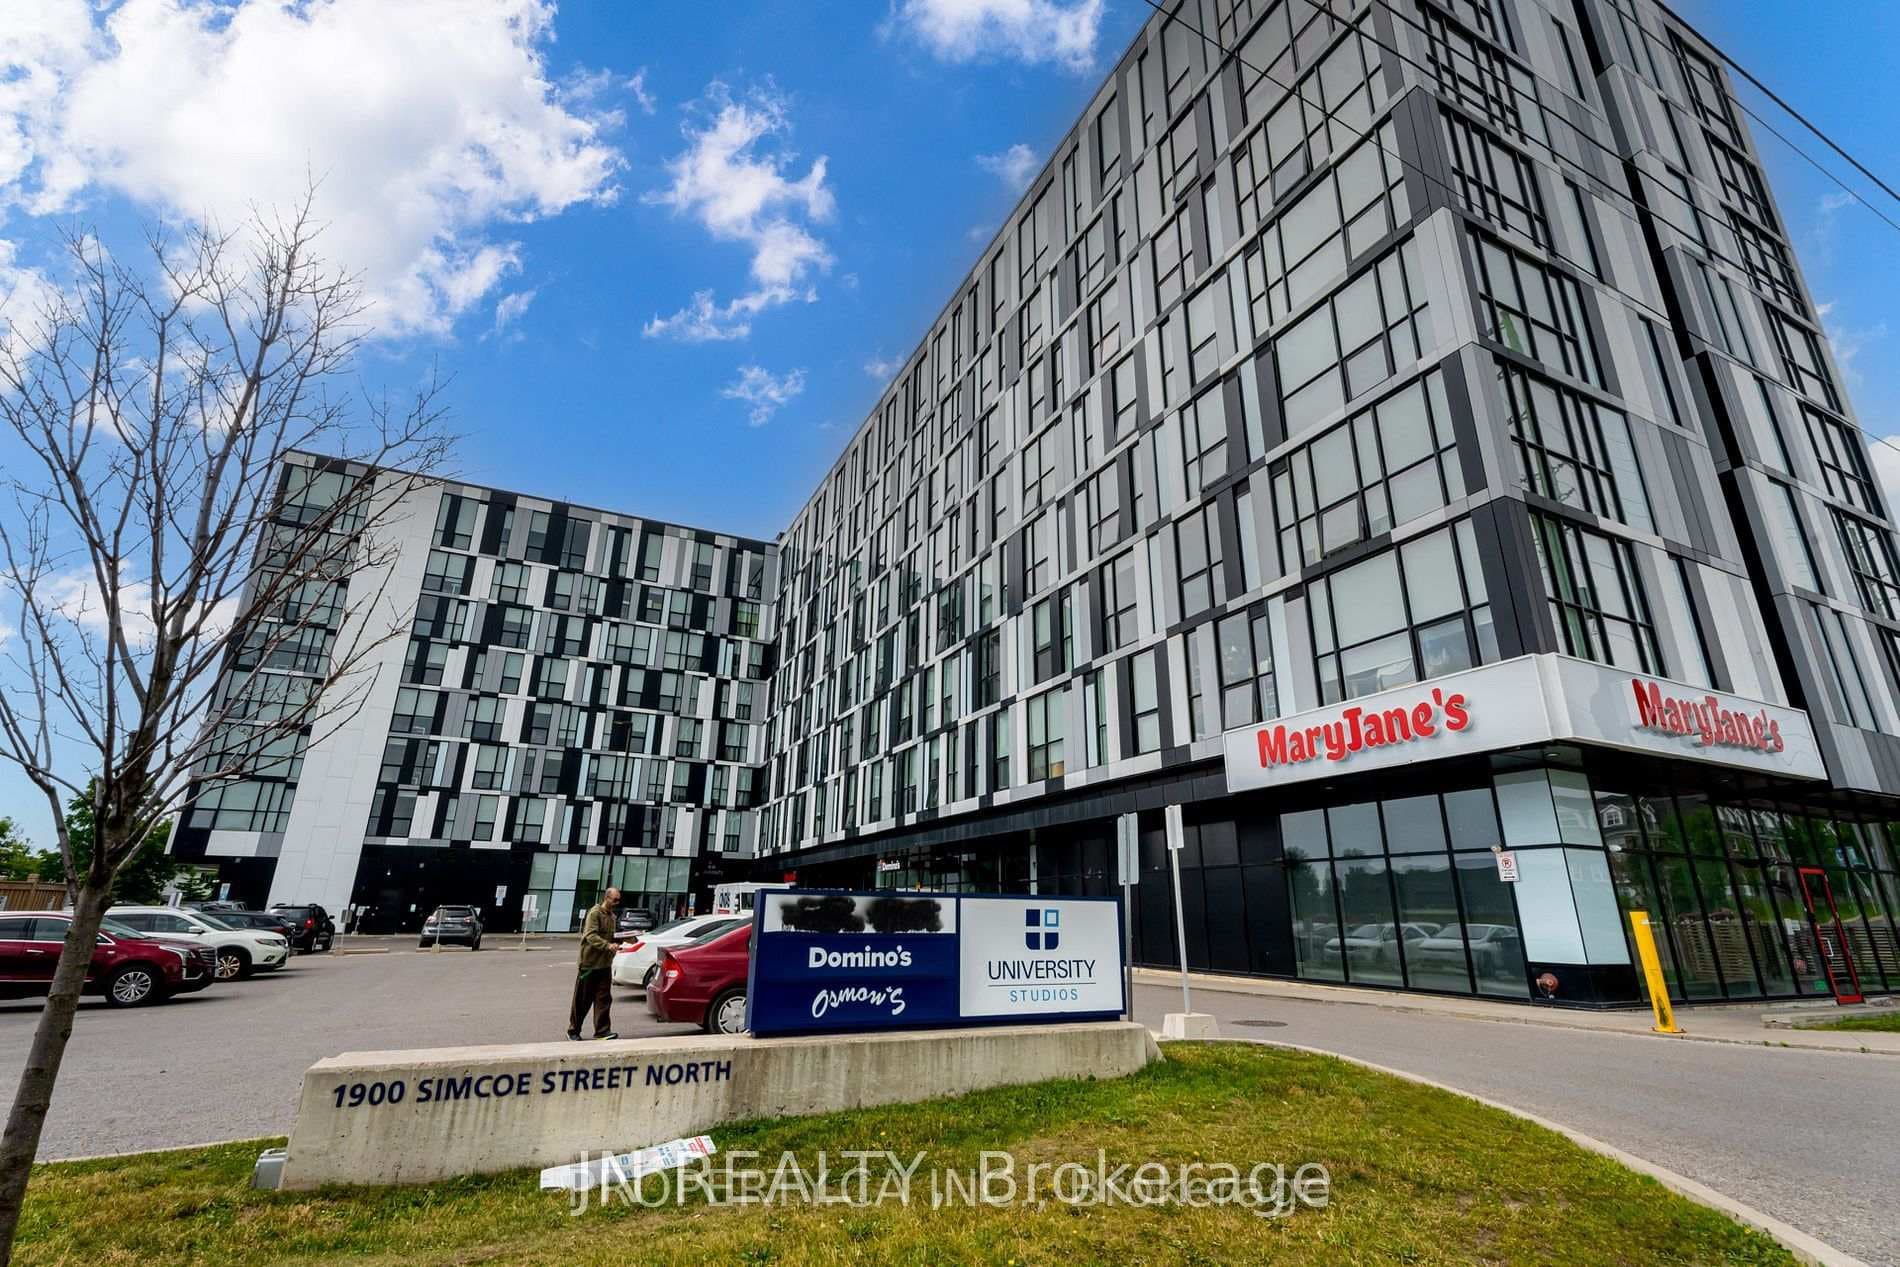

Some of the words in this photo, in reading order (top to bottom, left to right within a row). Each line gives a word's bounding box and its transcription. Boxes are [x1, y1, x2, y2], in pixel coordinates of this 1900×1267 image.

[1256, 687, 1470, 769] MaryJane's
[1632, 678, 1785, 753] MaryJane's
[808, 945, 912, 968] Domino's
[988, 959, 1096, 980] UNIVERSITY
[1009, 989, 1079, 1003] STUDIOS
[331, 1080, 406, 1108] 1900
[415, 1073, 532, 1104] SIMCOE
[541, 1066, 638, 1095] STREET
[645, 1061, 732, 1087] NORTH
